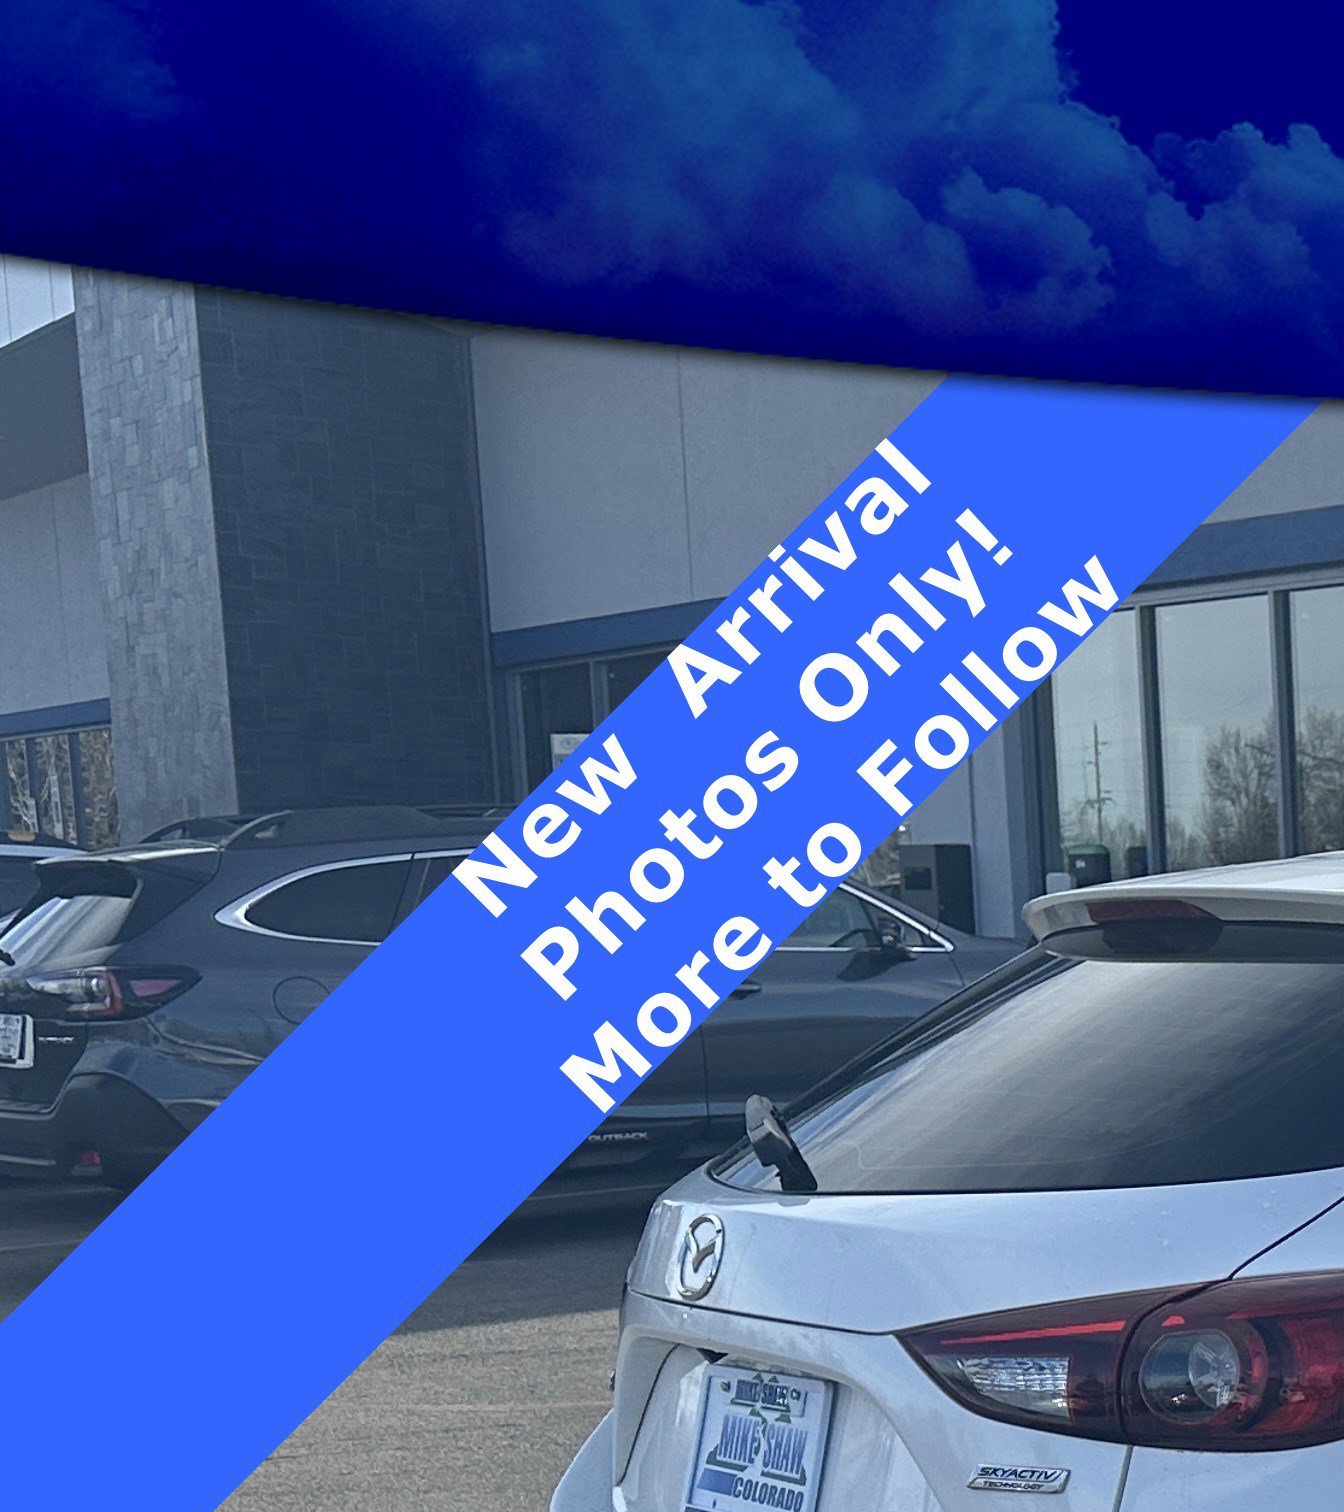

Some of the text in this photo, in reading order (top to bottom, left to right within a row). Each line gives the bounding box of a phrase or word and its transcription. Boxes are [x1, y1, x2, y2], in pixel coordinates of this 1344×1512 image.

[588, 1131, 648, 1142] OUTBACK
[717, 1414, 809, 1475] MIKE SHAW
[977, 1466, 1058, 1480] SKYACTIV
[732, 1477, 805, 1512] COLORADO
